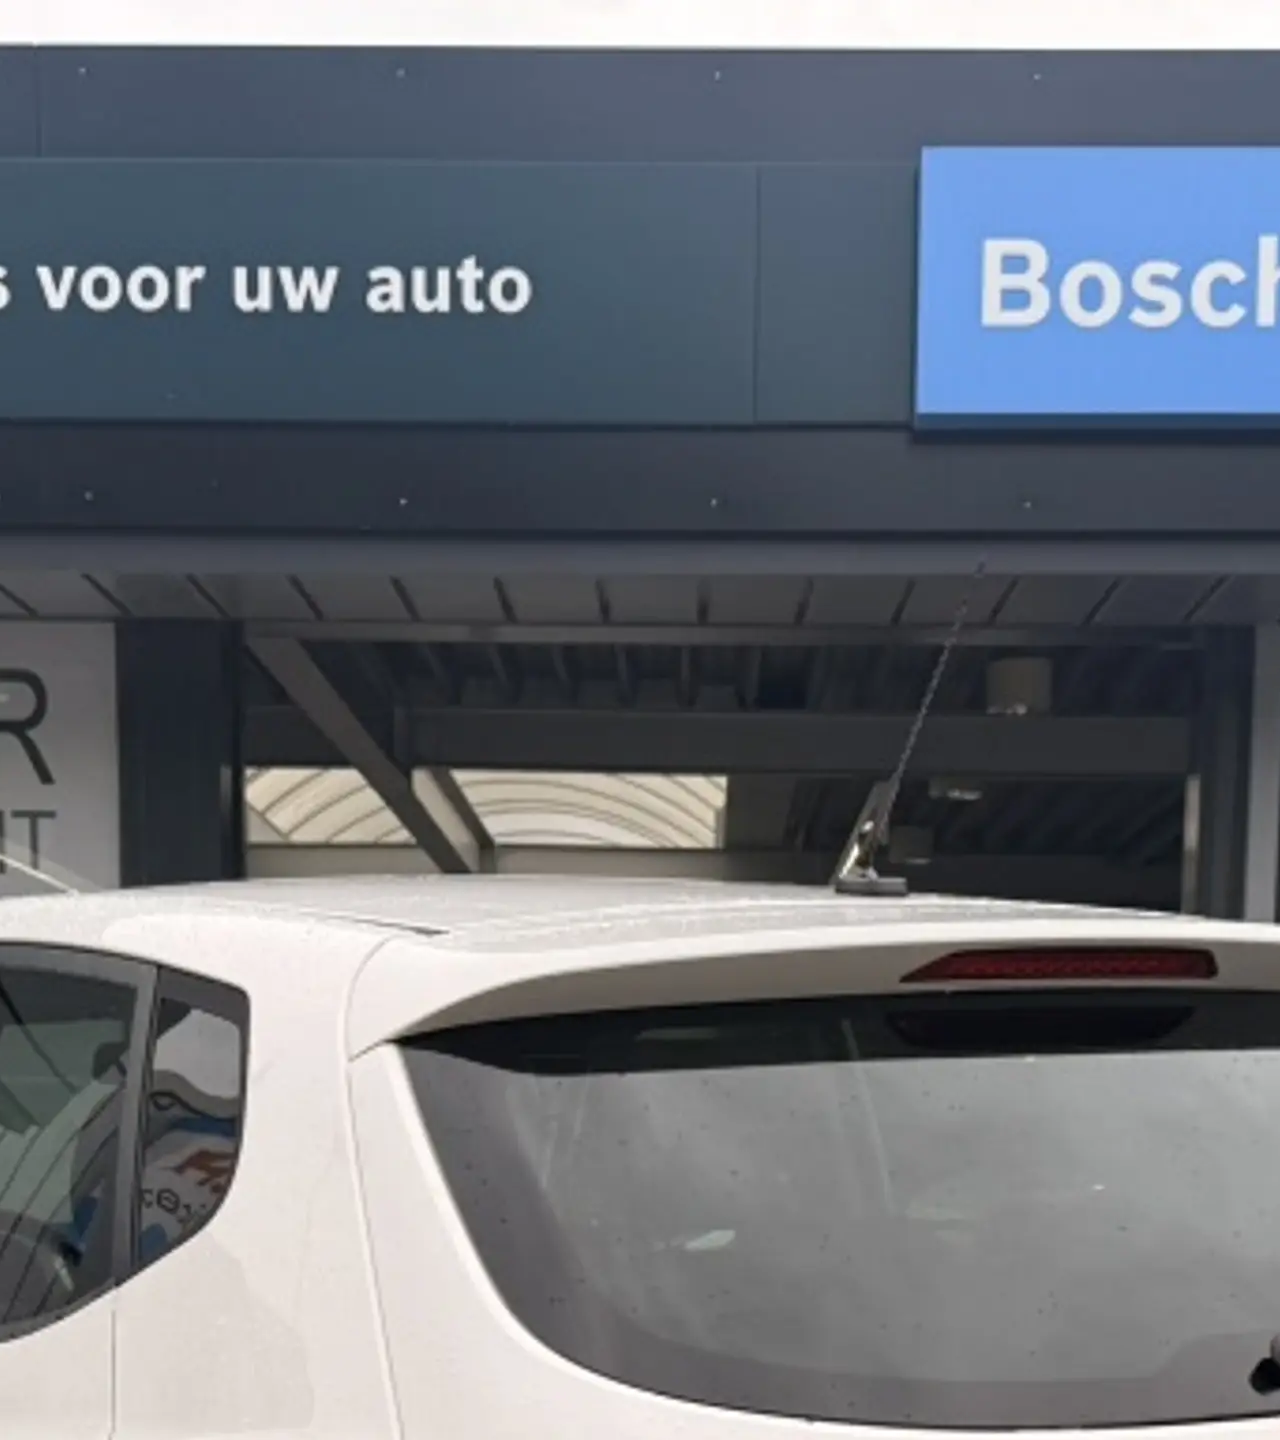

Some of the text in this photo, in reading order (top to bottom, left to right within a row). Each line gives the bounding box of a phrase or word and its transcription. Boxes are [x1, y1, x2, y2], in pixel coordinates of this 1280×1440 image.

[36, 264, 206, 312] voor
[233, 264, 338, 313] uw
[366, 255, 532, 314] auto
